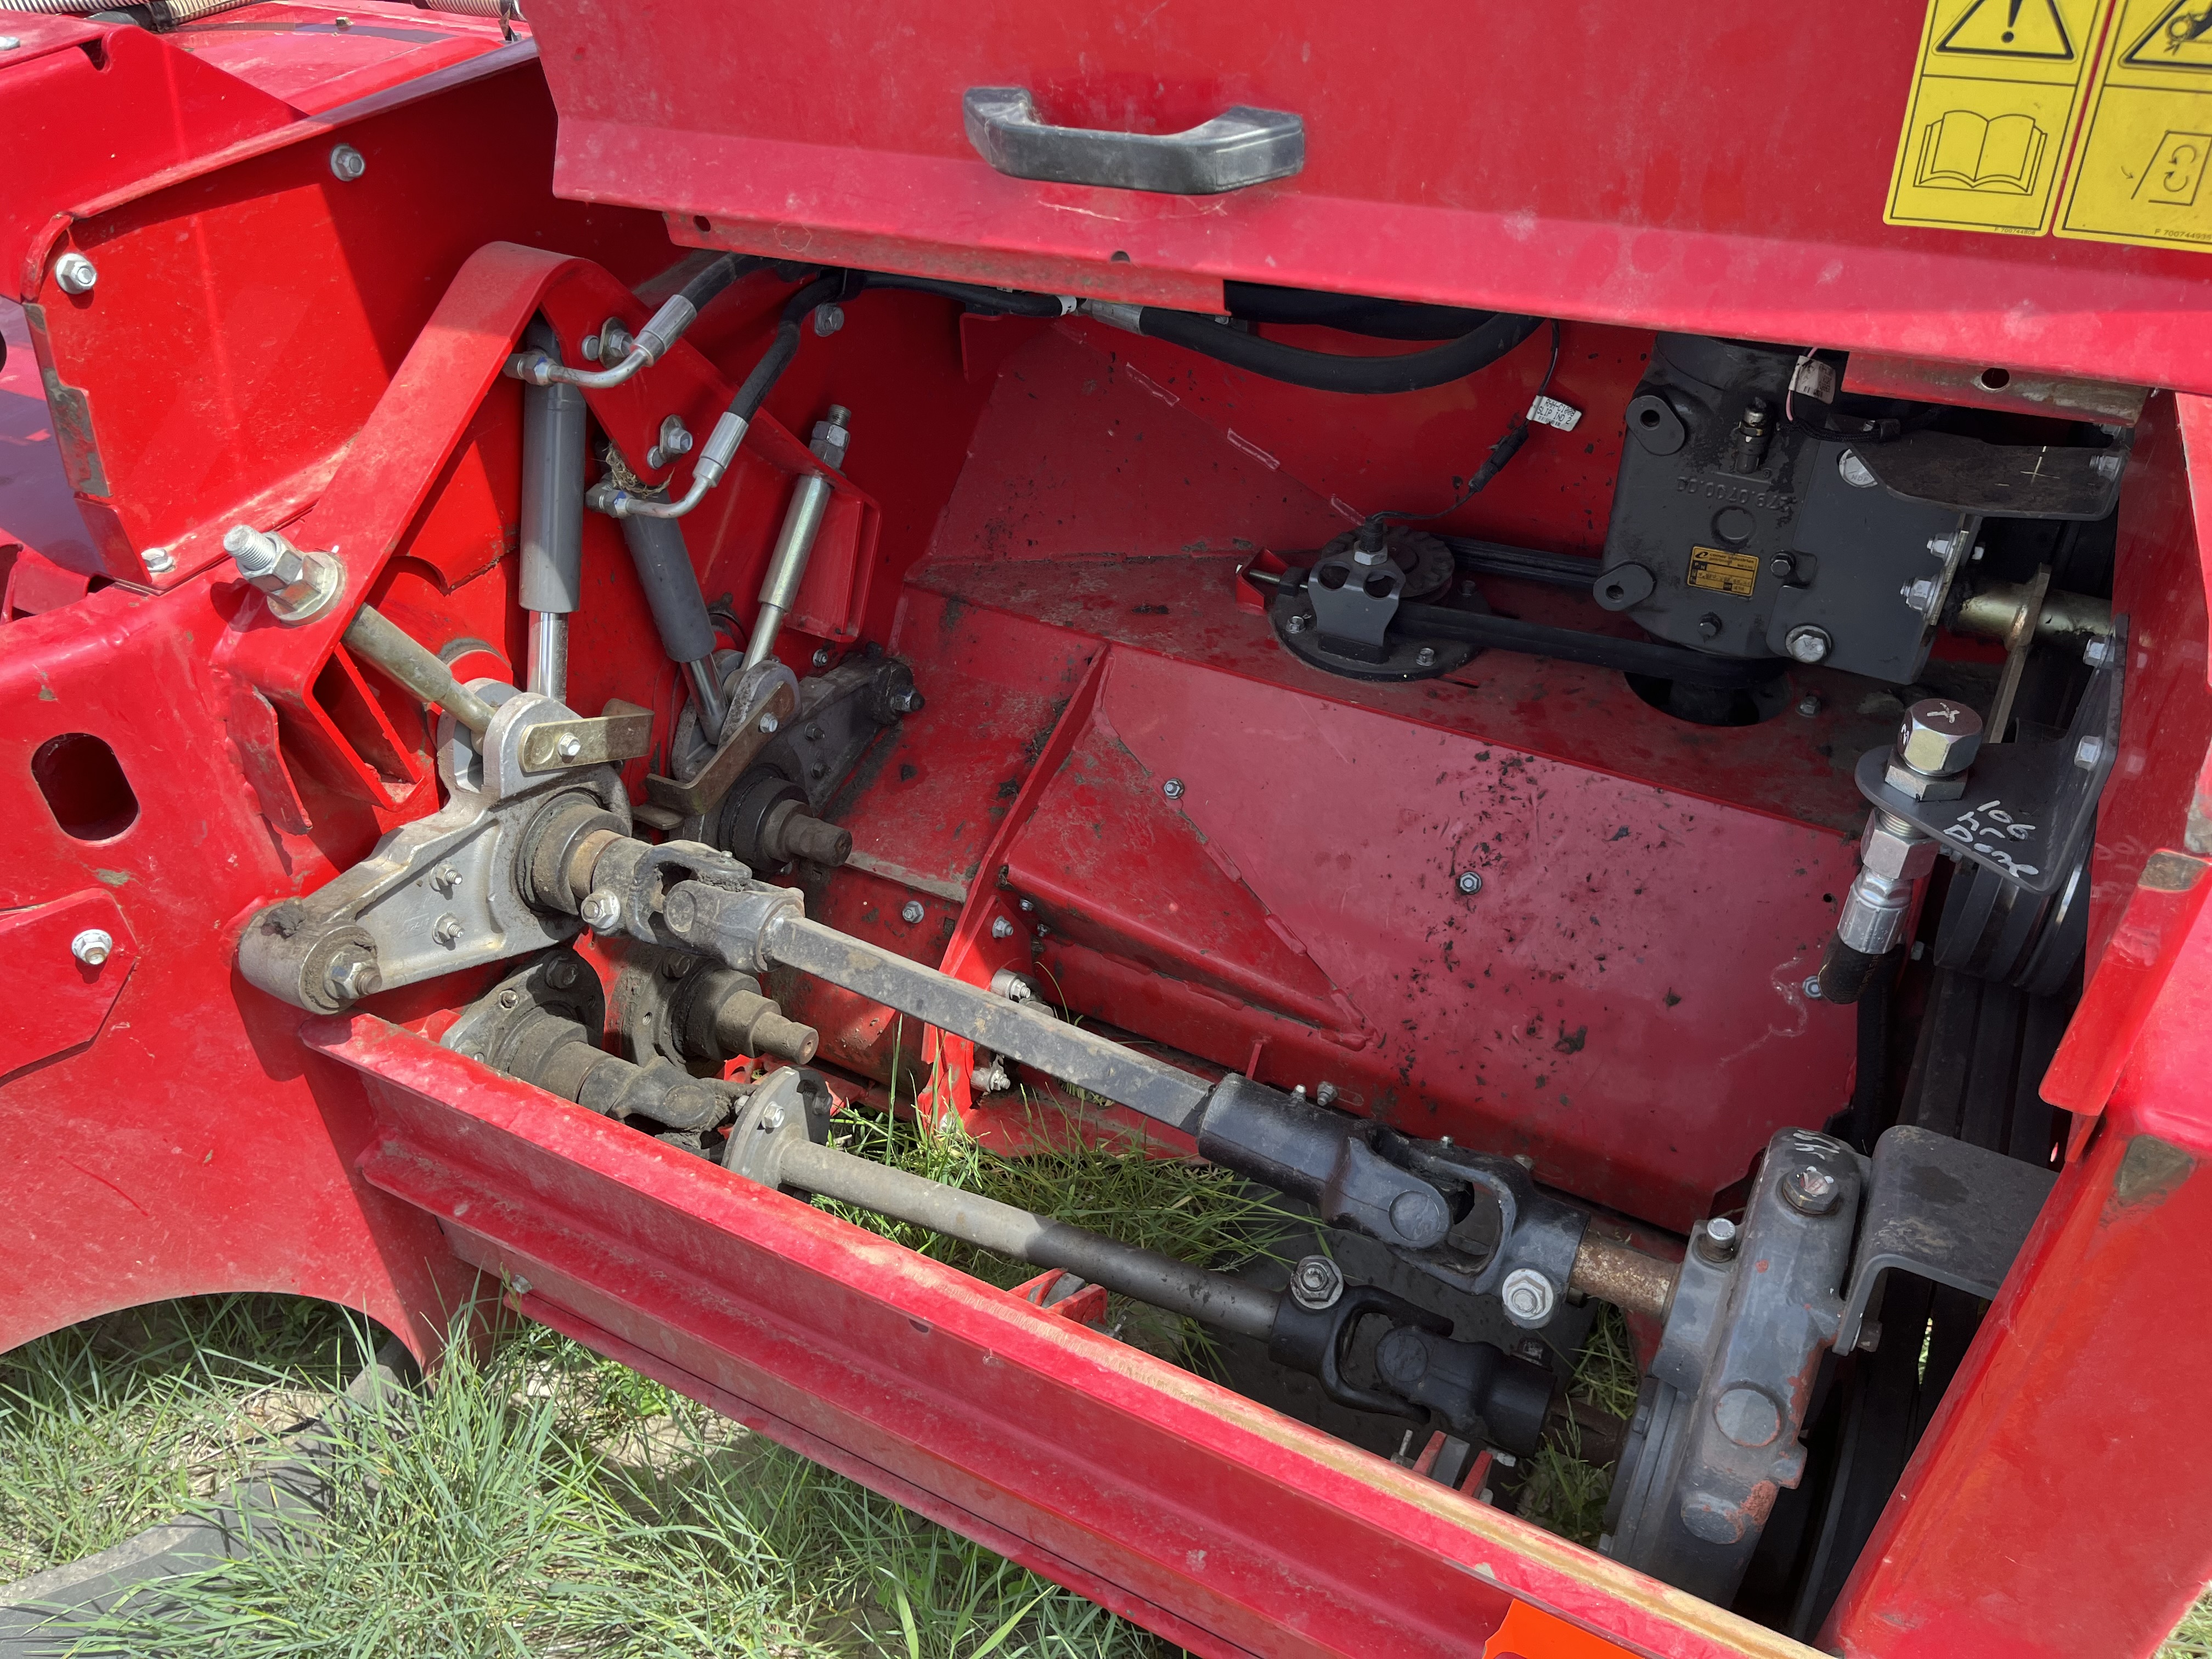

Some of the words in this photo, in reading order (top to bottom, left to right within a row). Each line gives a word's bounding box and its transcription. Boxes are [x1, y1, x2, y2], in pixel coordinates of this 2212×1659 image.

[1537, 406, 1553, 416] SLIP
[1553, 411, 1565, 422] IND
[1976, 800, 2036, 840] 106
